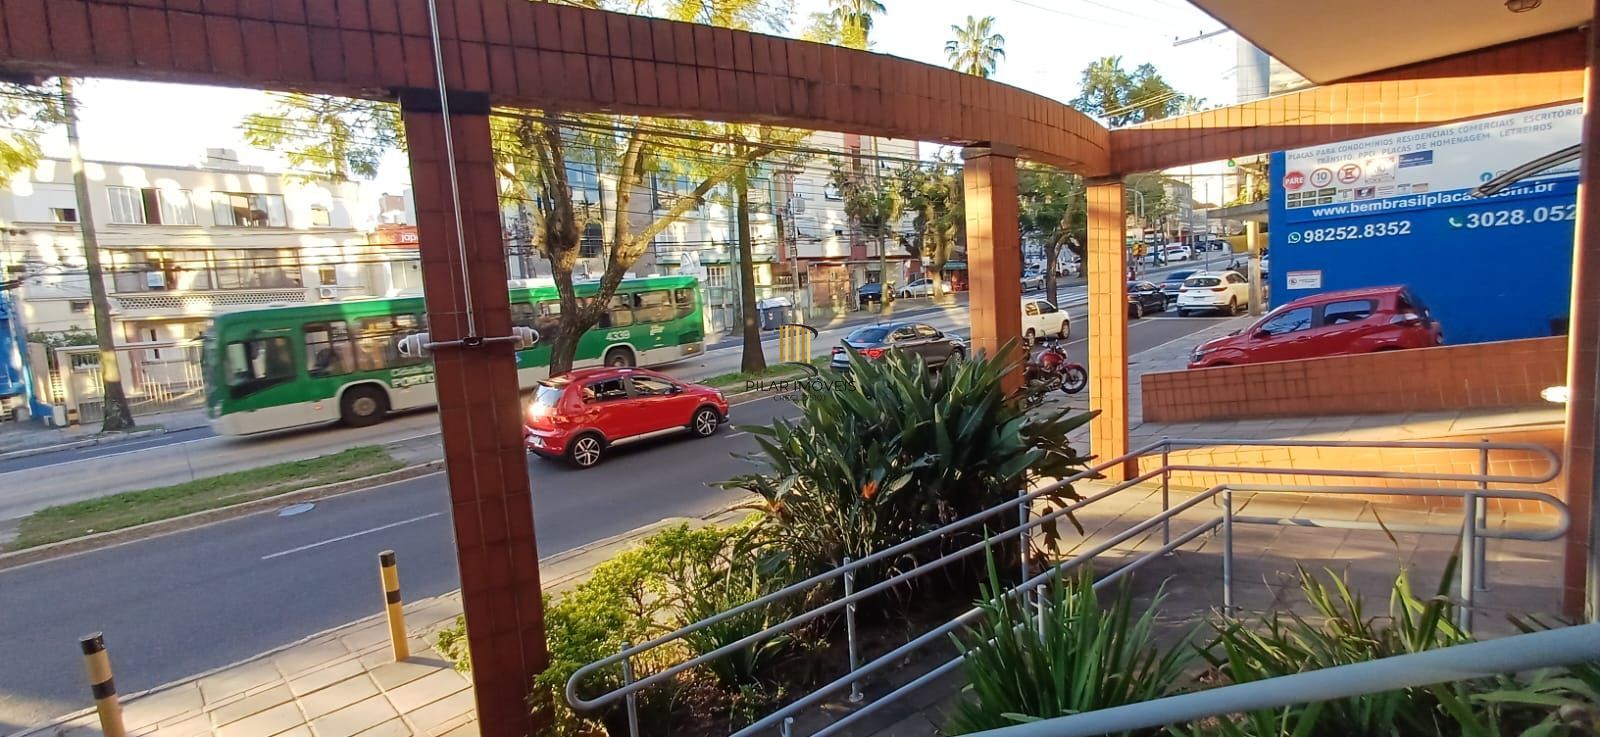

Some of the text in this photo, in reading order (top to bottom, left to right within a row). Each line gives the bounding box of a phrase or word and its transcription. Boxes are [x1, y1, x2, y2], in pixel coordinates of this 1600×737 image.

[1316, 147, 1336, 157] PARA
[1396, 127, 1455, 143] RESIDENCIAIS
[1457, 118, 1515, 135] COMERCIAIS
[1523, 107, 1583, 124] ESCRITÓRIO
[1382, 143, 1412, 155] PLACAS
[1415, 140, 1428, 150] DE
[1430, 132, 1491, 148] HOMENAGEM
[1499, 122, 1553, 138] LETREIROS
[1284, 174, 1305, 186] PARE
[1316, 171, 1328, 181] 10
[1312, 181, 1557, 217] www.bembrasilplaca.om.br
[1466, 204, 1578, 229] 3028.052
[1303, 220, 1412, 243] 98252.8352
